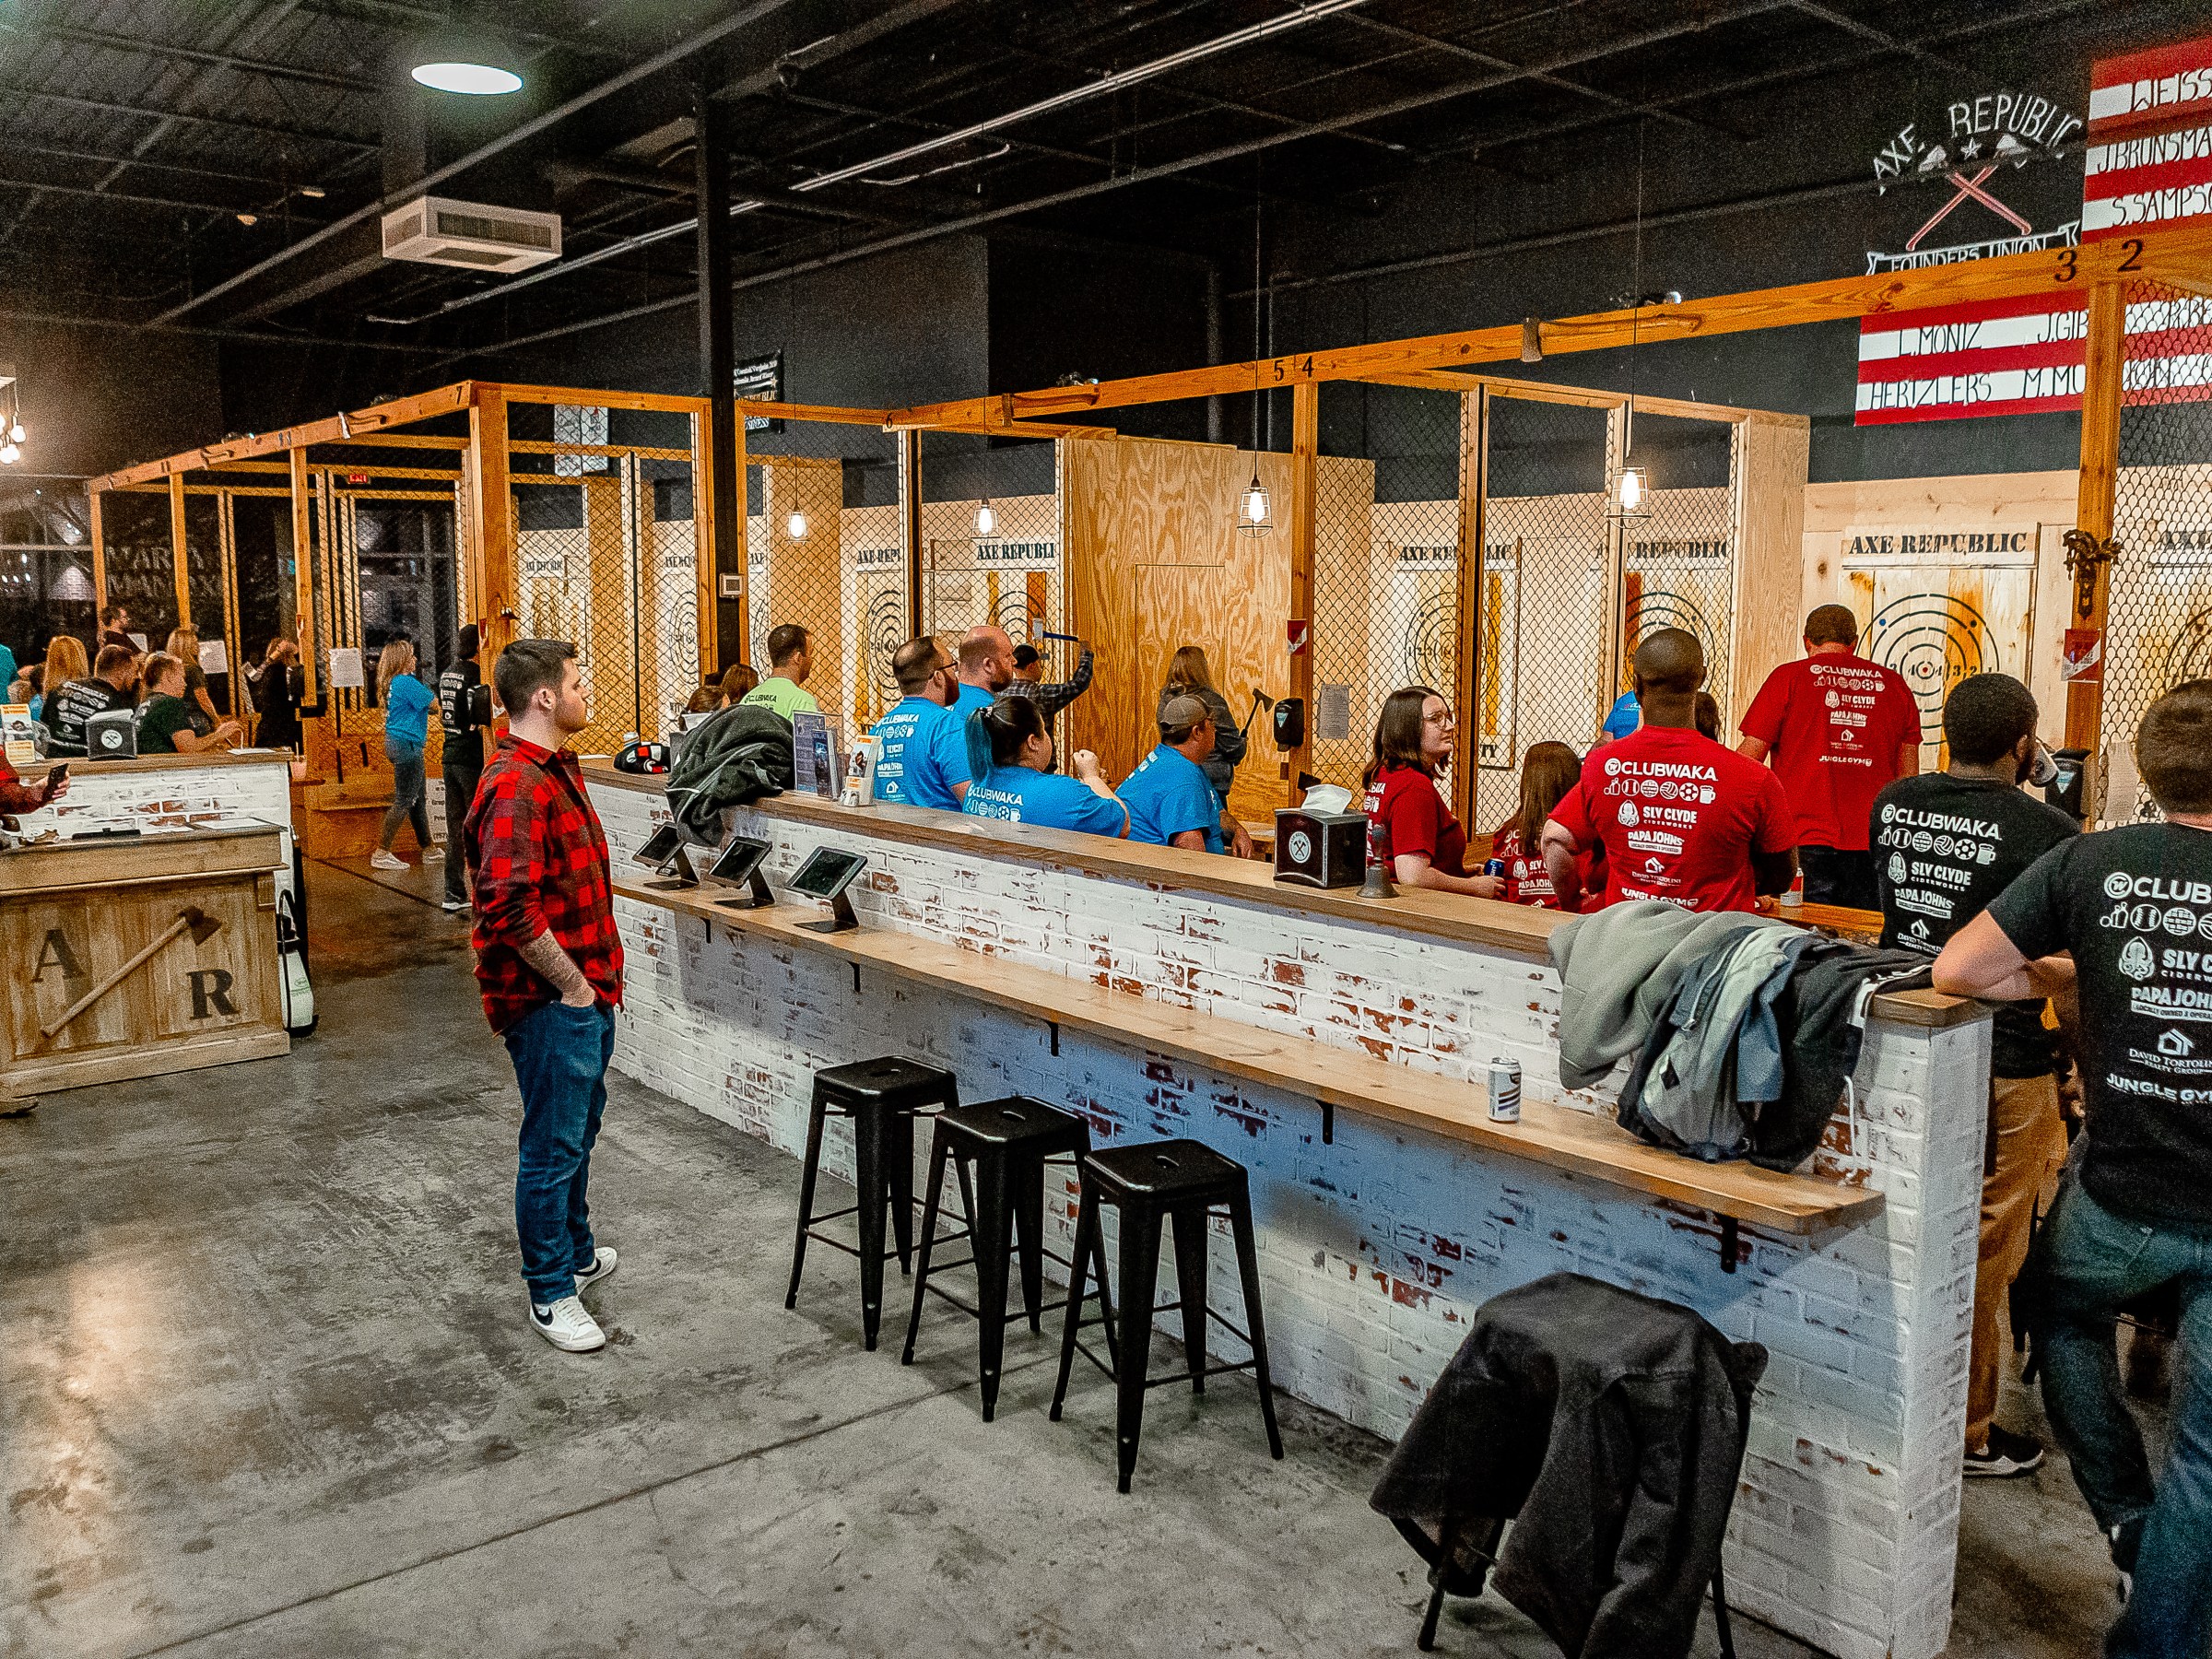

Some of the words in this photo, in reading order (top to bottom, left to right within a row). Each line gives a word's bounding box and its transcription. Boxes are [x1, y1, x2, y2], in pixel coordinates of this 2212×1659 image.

[1948, 94, 2083, 148] REPUBLIC
[1989, 236, 2048, 258] UNION
[2117, 239, 2143, 272] 2
[2054, 250, 2077, 282] 3
[1274, 359, 1284, 382] 5
[1301, 356, 1314, 377] 4
[886, 412, 893, 429] 6
[977, 545, 1000, 560] AXE
[1002, 542, 1054, 559] REPUBLI
[1400, 547, 1428, 561] AXE
[1849, 535, 1894, 555] AXE
[1900, 533, 2028, 555] REPUBLIC
[1642, 806, 1662, 819] SLY
[1664, 807, 1698, 824] CLYDE
[1628, 830, 1651, 843] PAPA
[1651, 831, 1685, 846] JOHNS
[1911, 861, 1934, 877] SLY
[1934, 865, 1972, 886] CLYDE
[1911, 876, 1966, 892] CIDERWORKS
[1894, 888, 1919, 902] PAPA
[1920, 889, 1955, 910] JOHNS
[32, 928, 85, 983] A
[2162, 948, 2200, 971] SLY
[186, 969, 240, 1020] R
[2131, 986, 2171, 1006] PAPA
[2129, 1048, 2161, 1064] DAVID
[2145, 1060, 2171, 1073] REALTY
[2173, 1066, 2204, 1075] GROUP
[2106, 1072, 2178, 1099] JUNGLE
